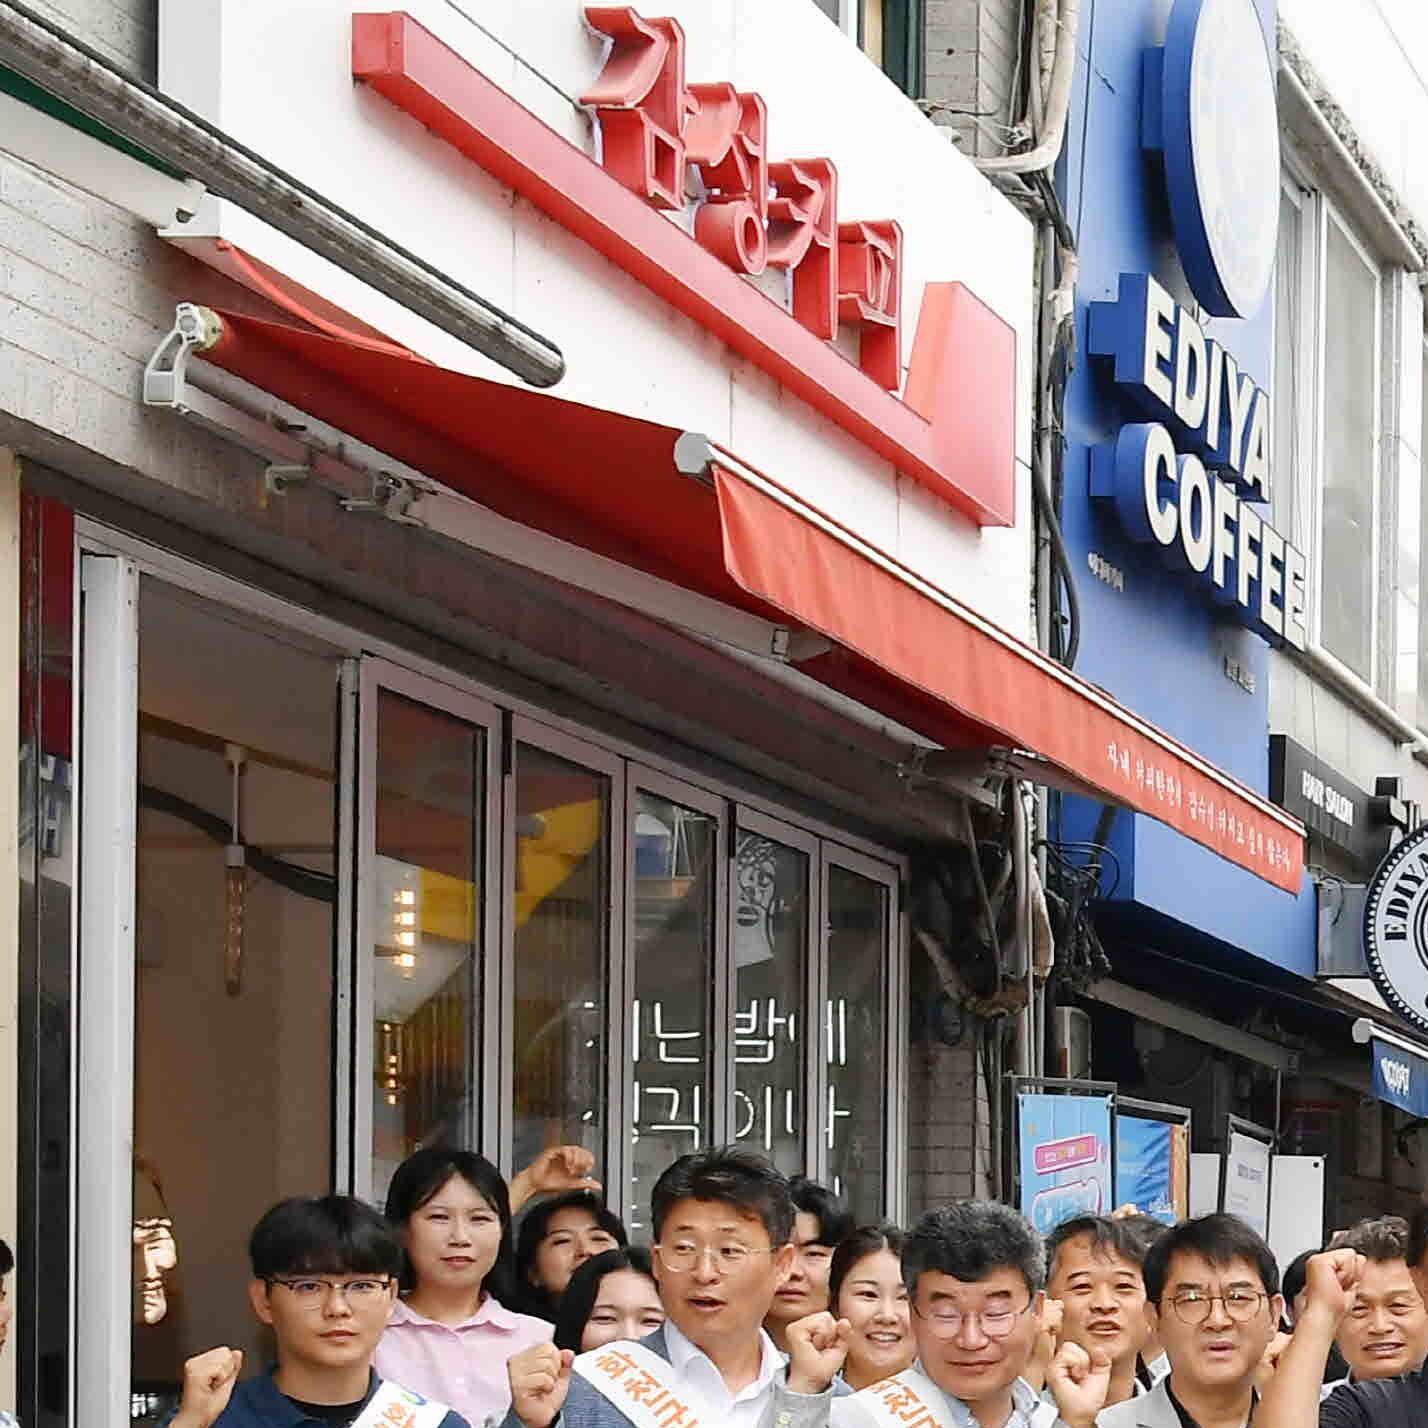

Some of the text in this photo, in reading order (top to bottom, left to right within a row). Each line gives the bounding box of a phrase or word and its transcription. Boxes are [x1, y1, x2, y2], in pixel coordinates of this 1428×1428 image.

[580, 5, 904, 392] 감성커피
[1143, 272, 1271, 504] EDIYA
[1143, 421, 1306, 653] COFFEE
